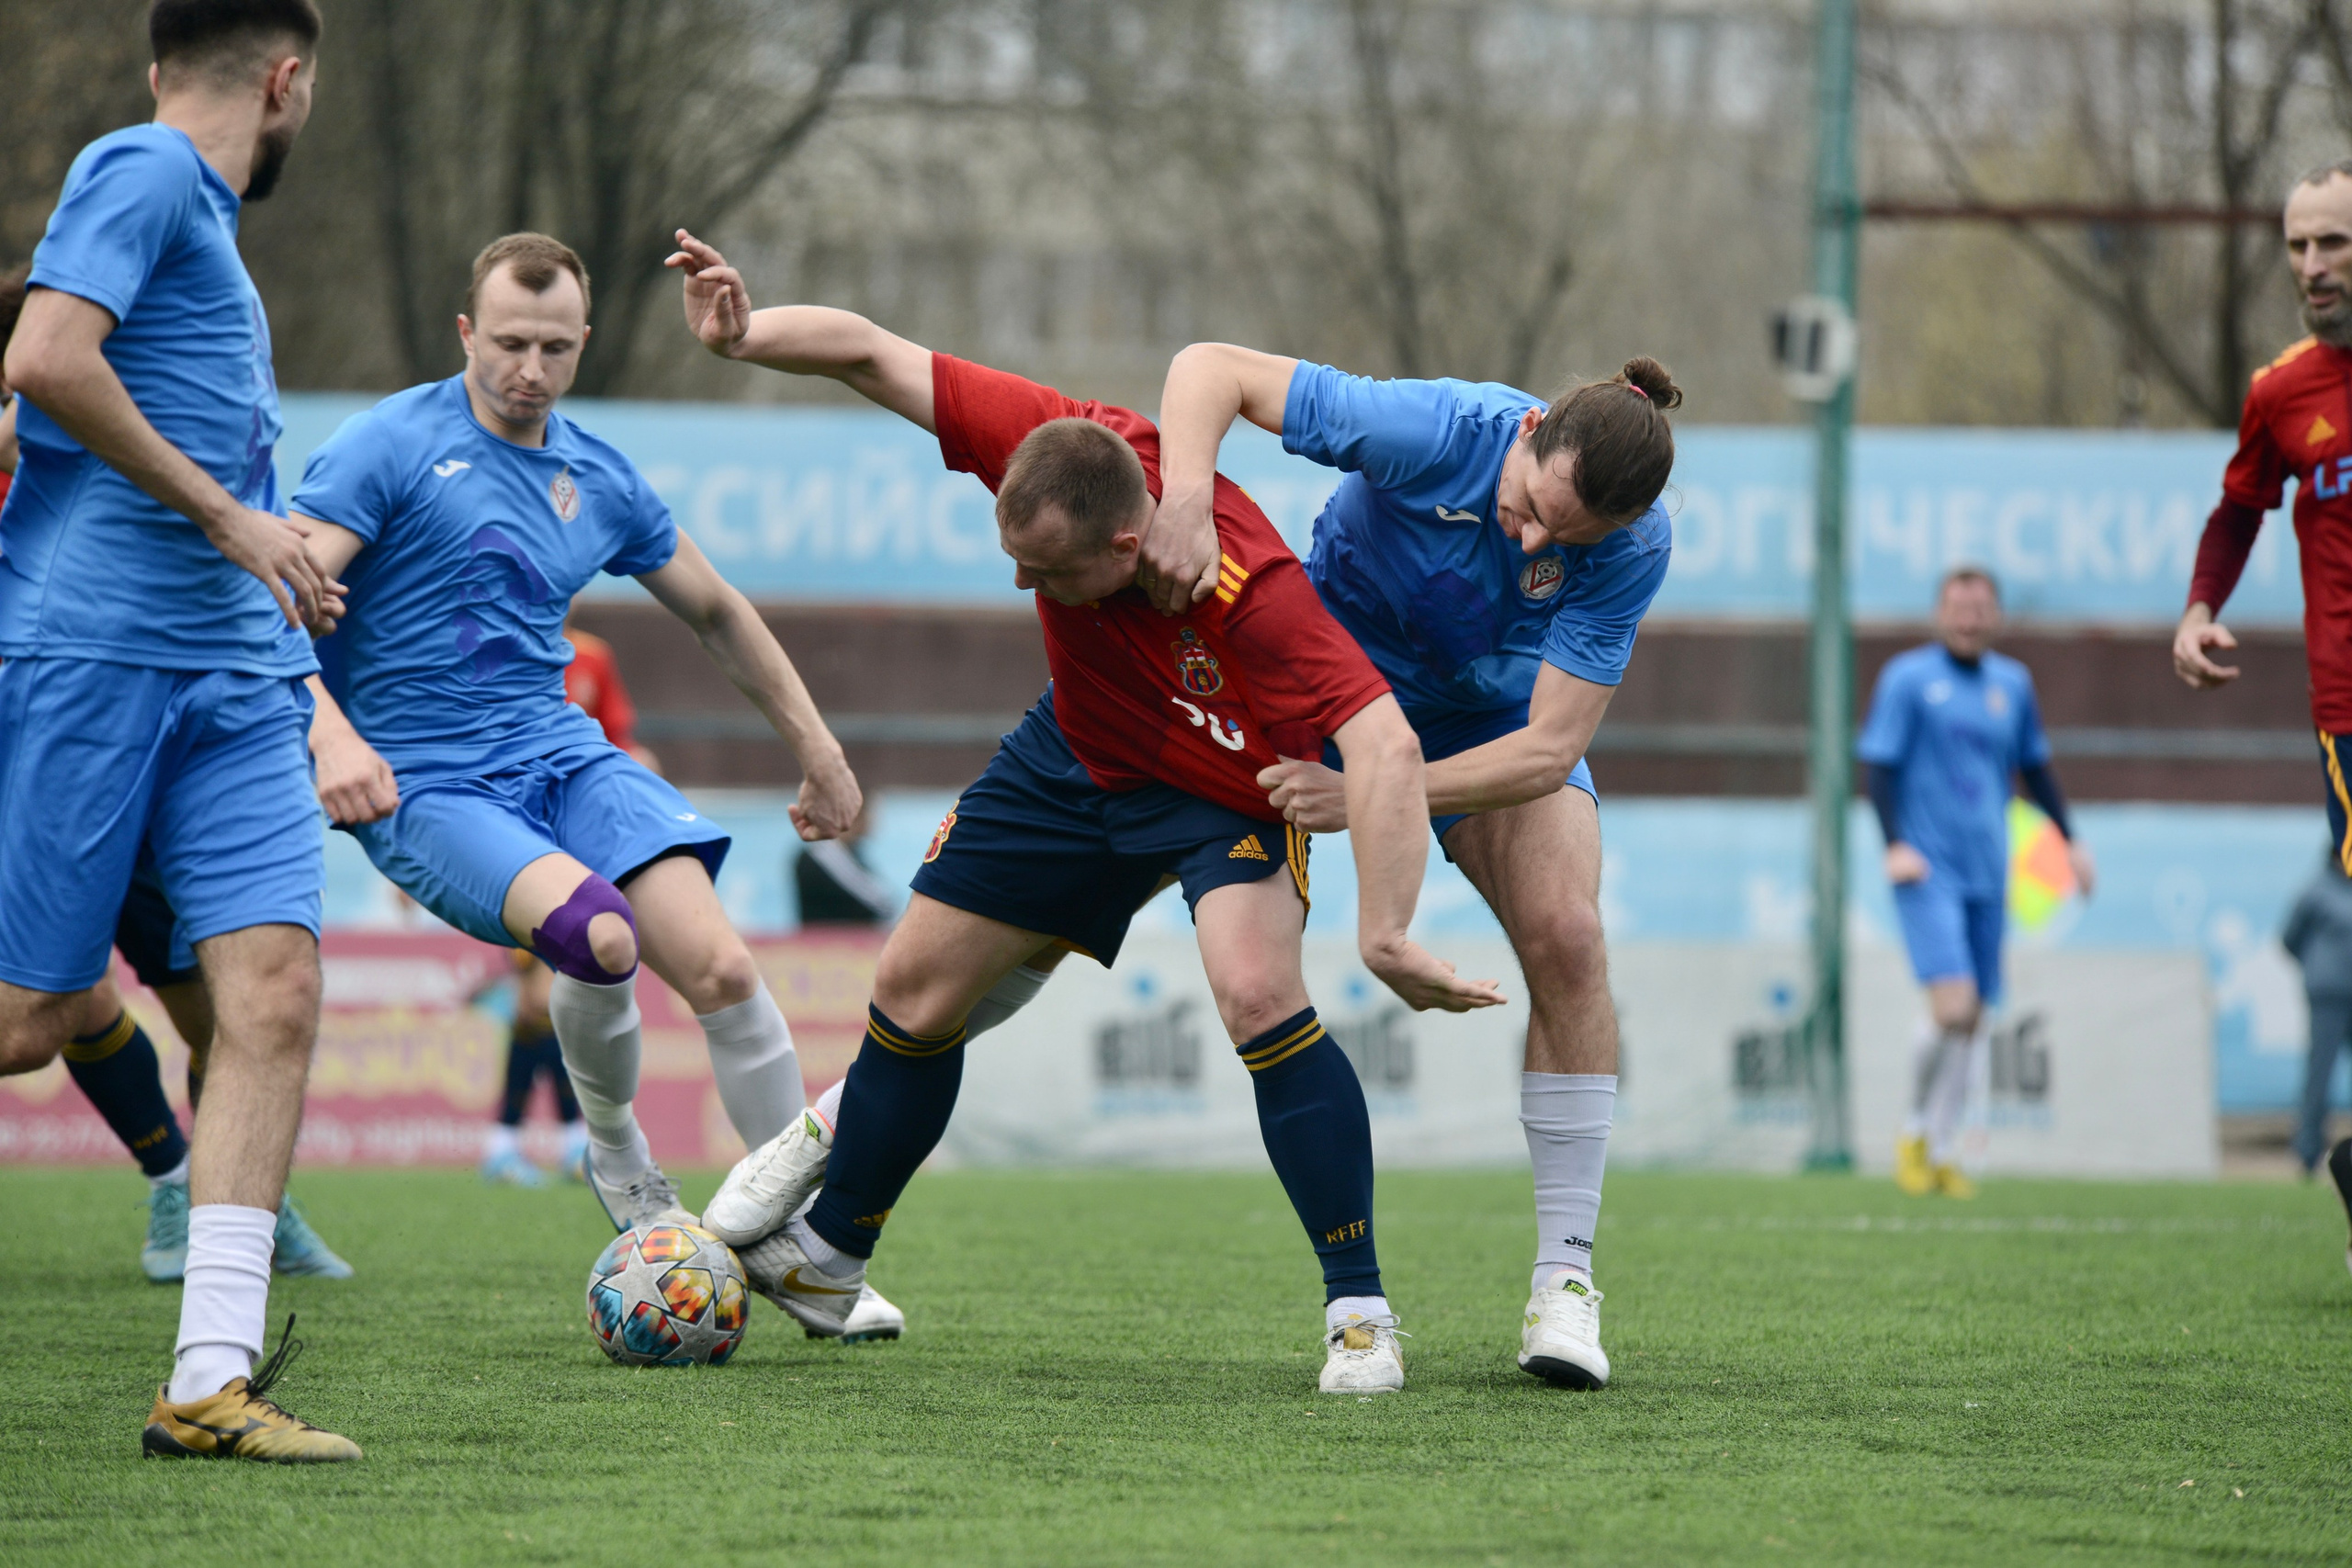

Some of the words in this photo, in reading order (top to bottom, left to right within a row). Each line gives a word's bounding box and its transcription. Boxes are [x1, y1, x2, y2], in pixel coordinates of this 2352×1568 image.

[1228, 850, 1269, 862] adidas
[1326, 1219, 1366, 1244] RFEF
[1565, 1235, 1592, 1249] Jom
[1567, 1280, 1588, 1296] Jom
